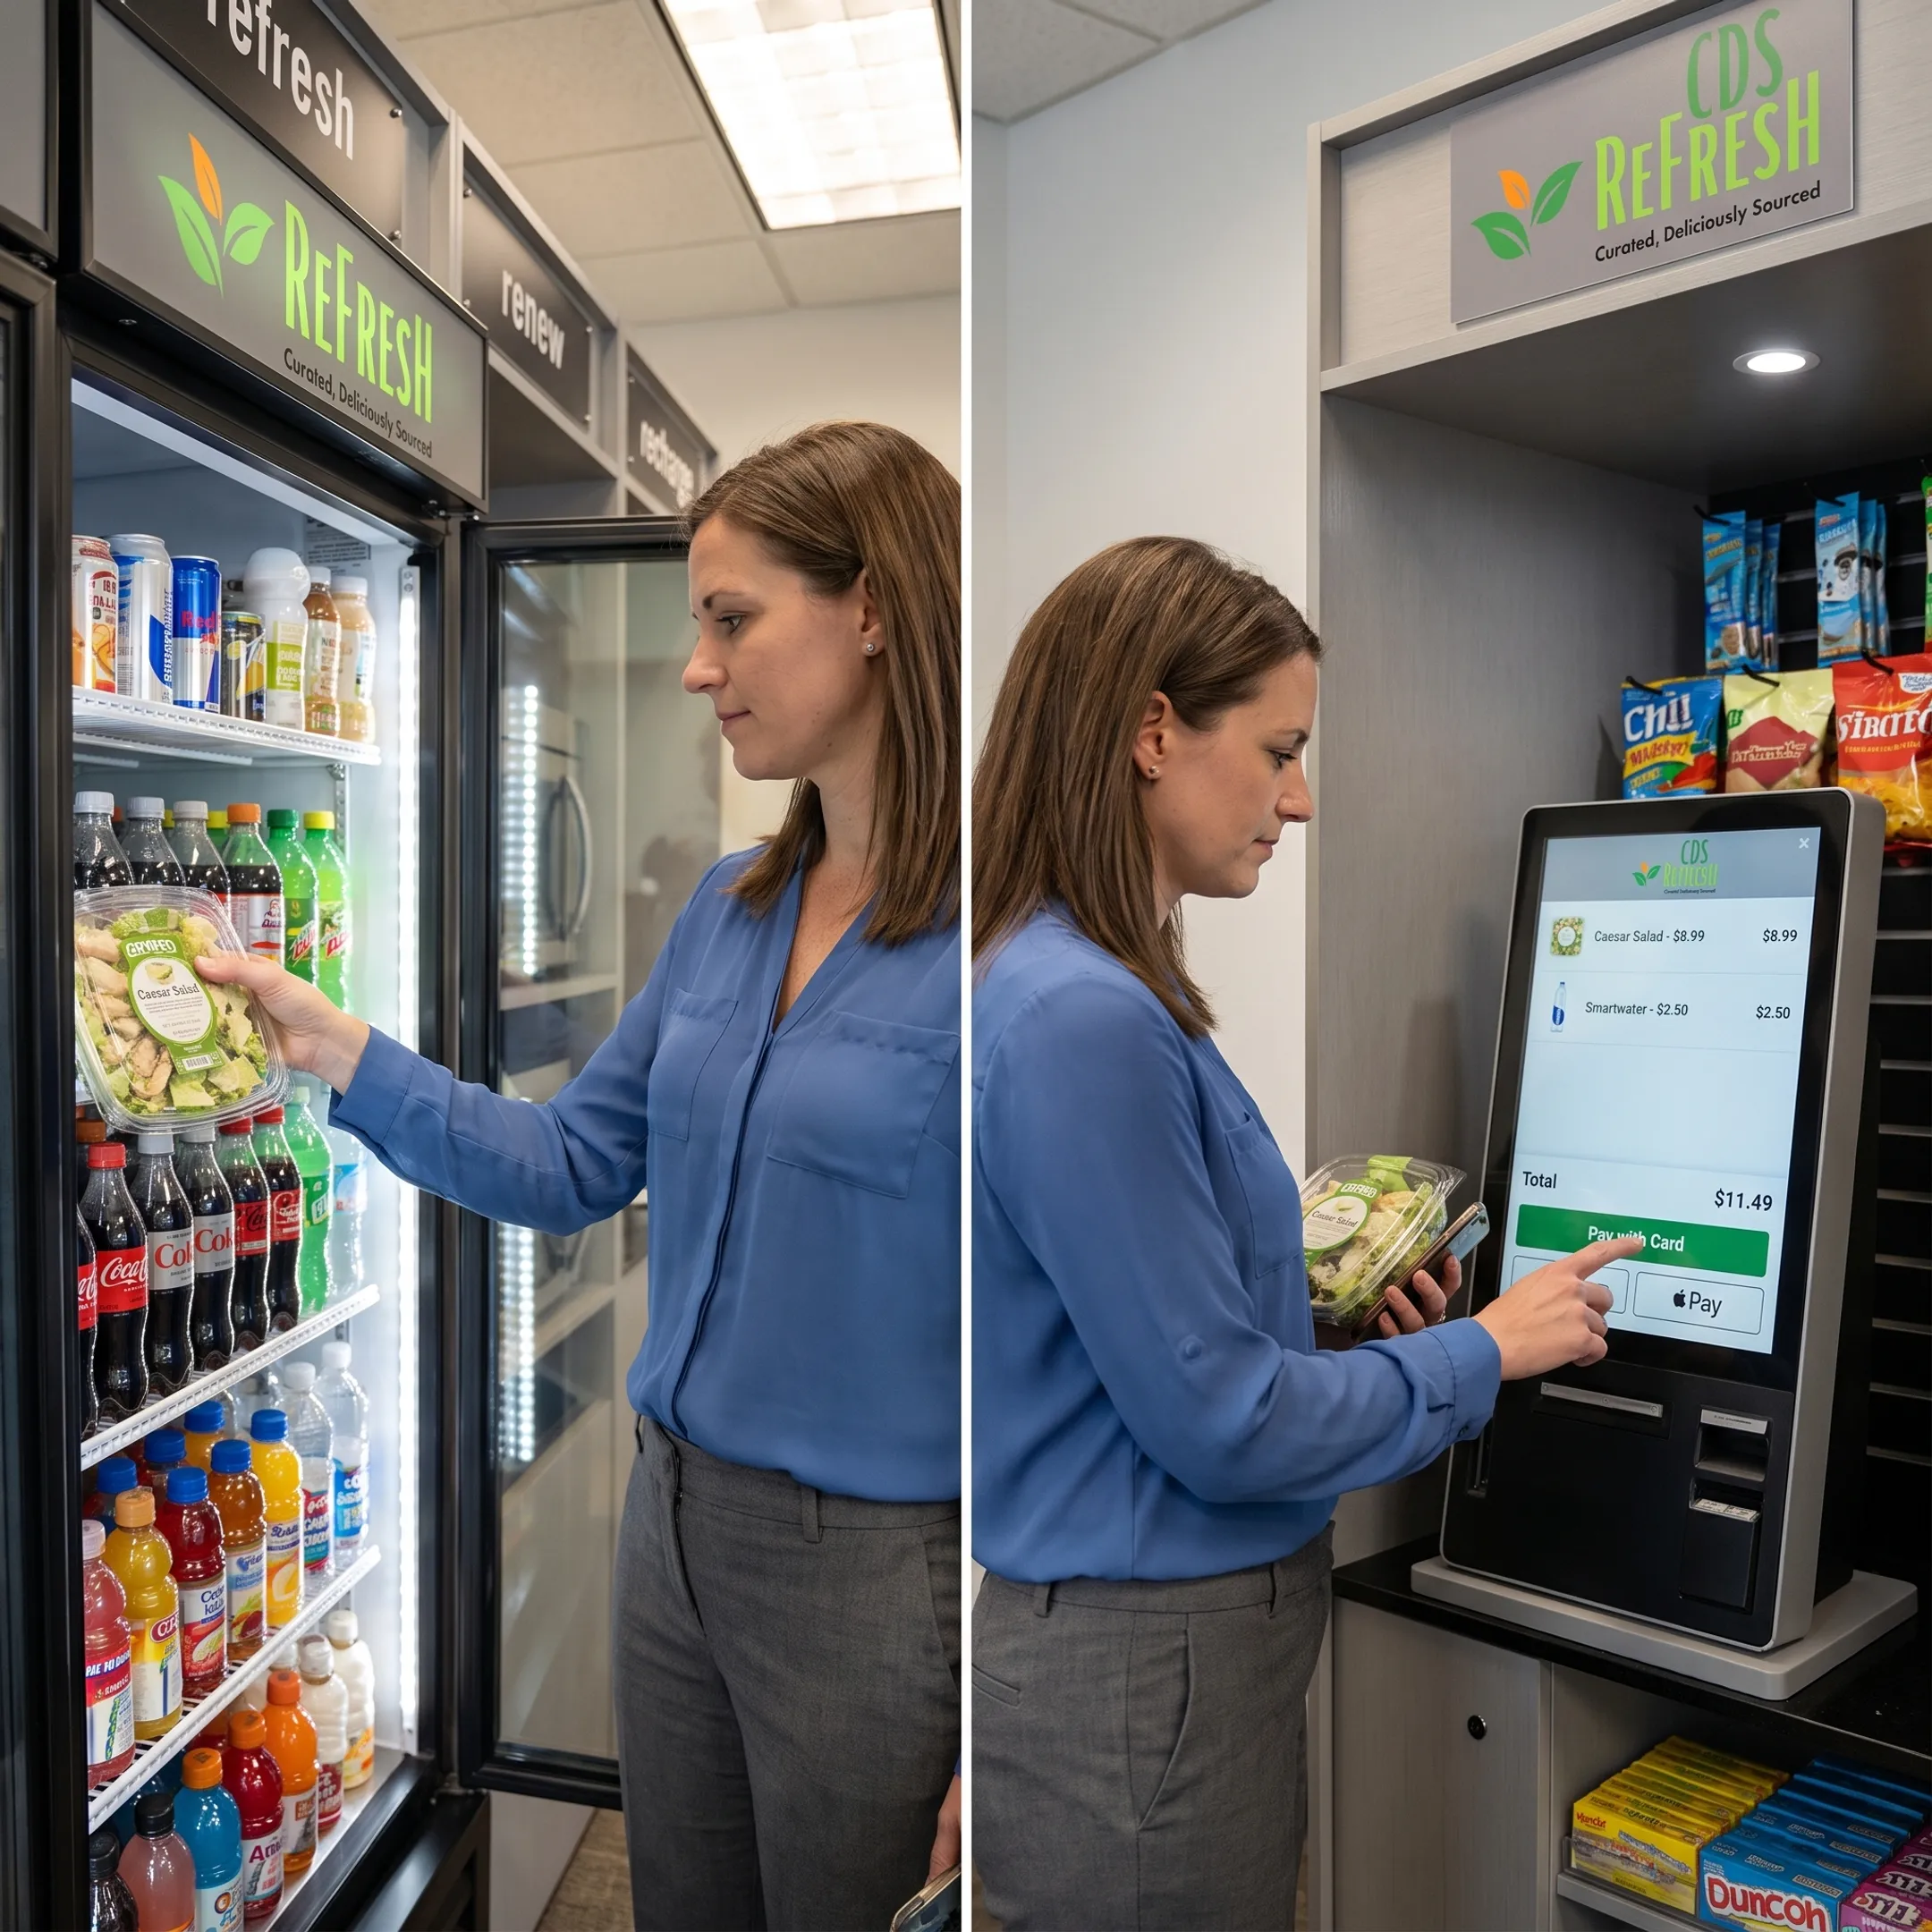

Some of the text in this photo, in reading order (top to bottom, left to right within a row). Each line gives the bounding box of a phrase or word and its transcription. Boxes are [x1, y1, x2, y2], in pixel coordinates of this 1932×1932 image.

[1687, 7, 1784, 119] CDS
[1595, 180, 1821, 261] Curated, Deliciously Sourced
[502, 269, 565, 370] renew
[284, 347, 432, 459] Curated, Deliciously Sourced
[1681, 839, 1709, 865] CDS
[1594, 930, 1631, 942] Caesar
[1632, 929, 1664, 942] Salad
[1673, 928, 1705, 944] $8.99
[1762, 928, 1798, 944] $8.99
[137, 987, 172, 1000] Caesar
[1585, 1002, 1647, 1015] Smartwater
[1657, 1003, 1689, 1017] $2.50
[1756, 1004, 1791, 1020] $2.50
[1522, 1171, 1557, 1189] Total
[1714, 1188, 1773, 1211] $11.49
[1650, 1233, 1685, 1252] Card
[1689, 1291, 1723, 1318] Pay
